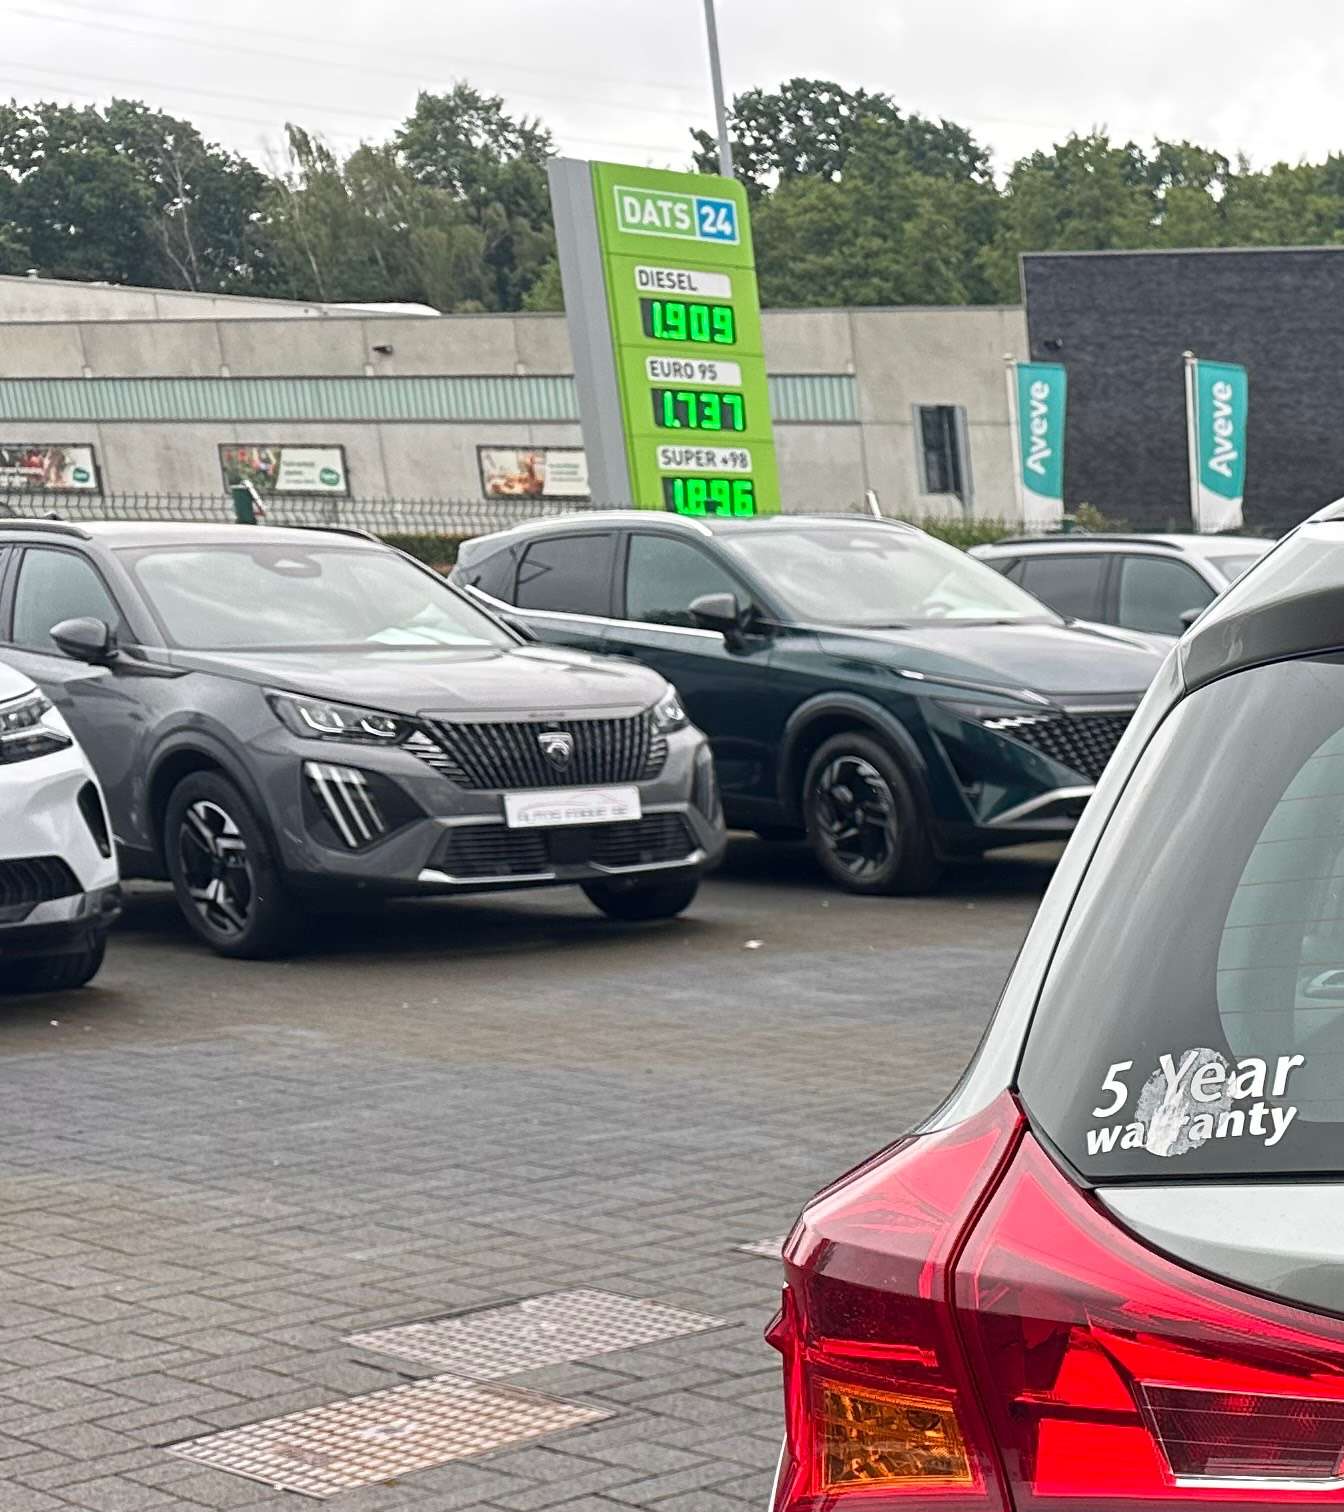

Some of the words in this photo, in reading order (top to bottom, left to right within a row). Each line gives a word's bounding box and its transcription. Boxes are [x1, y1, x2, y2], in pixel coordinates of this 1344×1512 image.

[623, 196, 692, 230] DATS
[701, 205, 733, 235] 24
[638, 269, 698, 292] DIESEL
[652, 301, 733, 344] 1.909
[649, 360, 695, 380] EURO
[699, 361, 718, 381] 95
[663, 390, 745, 432] 1.737
[1026, 379, 1051, 475] Aveve
[1208, 380, 1239, 478] Aveve
[660, 449, 718, 468] SUPER
[1092, 1060, 1133, 1118] 5
[1159, 1048, 1306, 1107] Year
[1086, 1102, 1298, 1156] waranty
